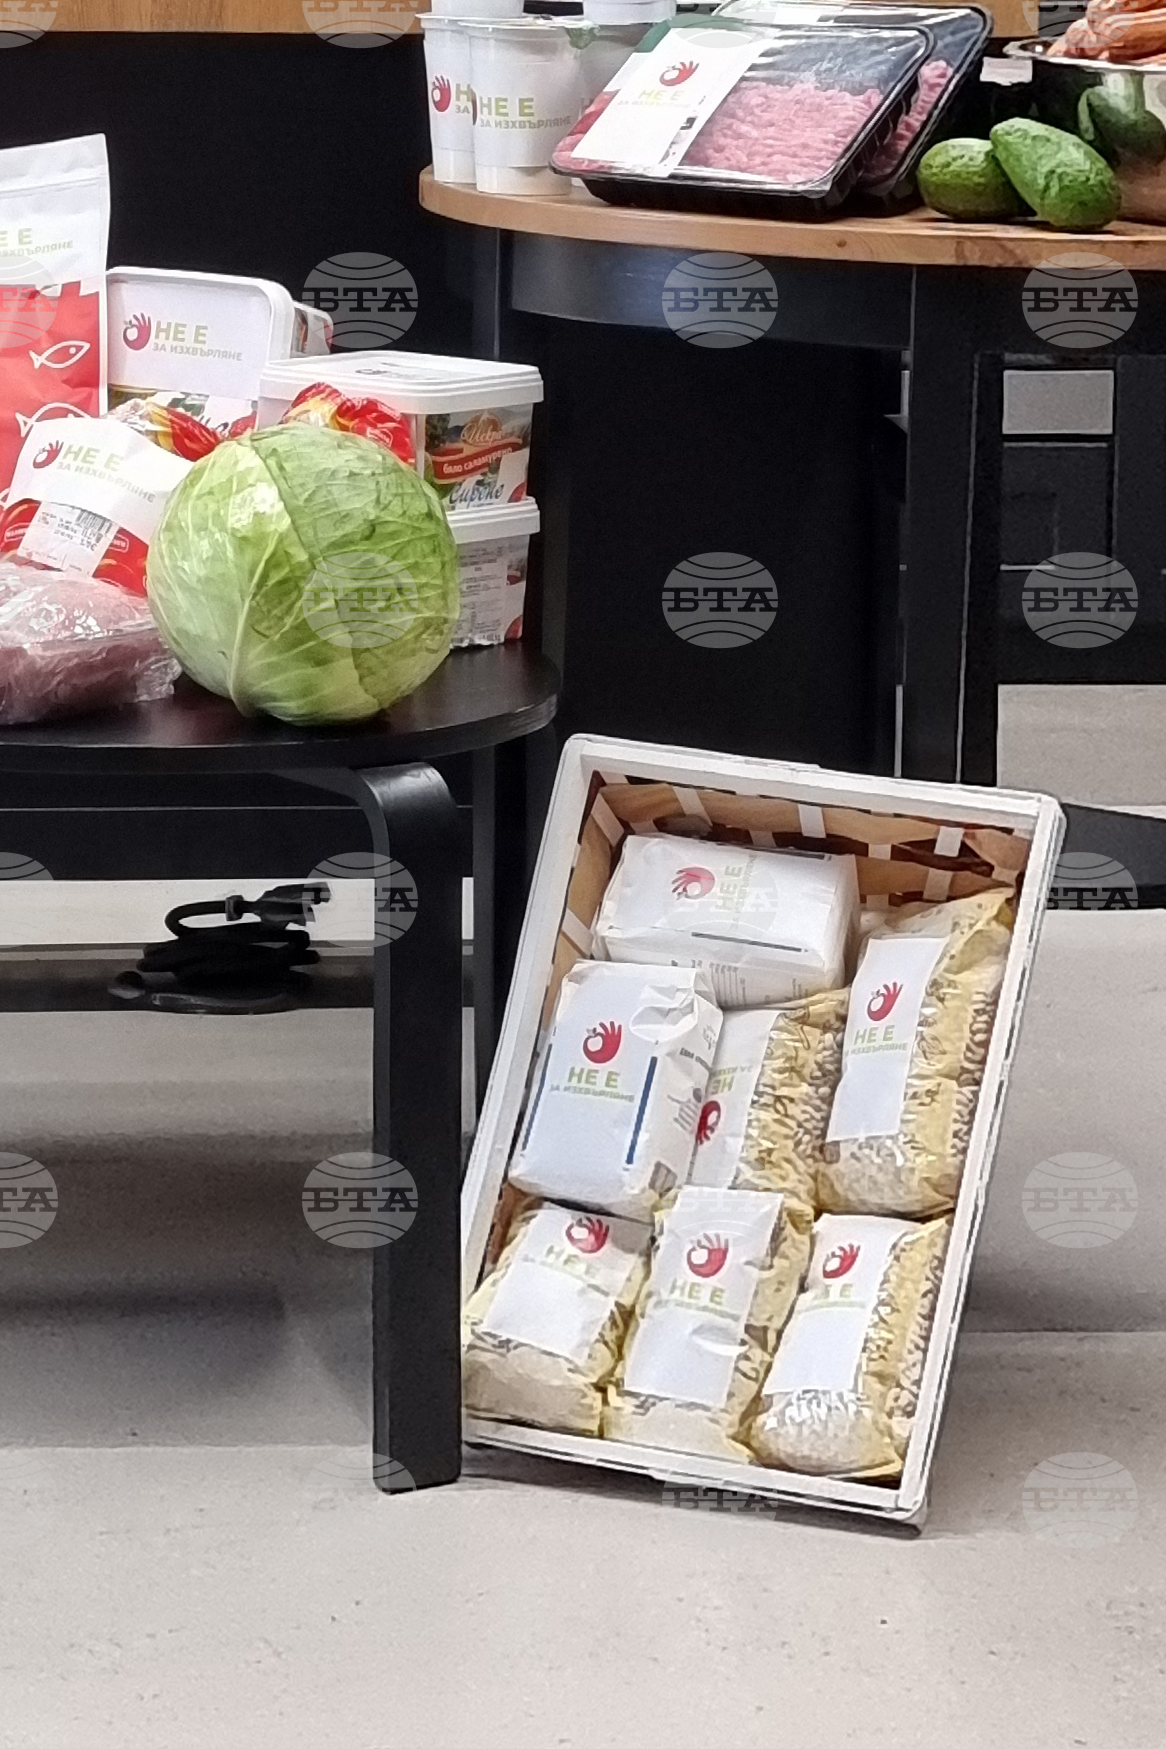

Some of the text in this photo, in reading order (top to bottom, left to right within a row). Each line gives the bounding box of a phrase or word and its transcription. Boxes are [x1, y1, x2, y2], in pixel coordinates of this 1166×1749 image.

[455, 105, 470, 114] ЗА
[479, 96, 535, 117] НЕ Е
[480, 120, 491, 128] ЗА
[18, 227, 33, 246] Е
[154, 320, 209, 345] НЕ Е
[152, 342, 167, 353] ЗА
[56, 461, 71, 472] ЗА
[62, 444, 123, 472] НЕ Е
[442, 447, 513, 476] бяло саламурено
[448, 482, 504, 510] Сирене
[714, 864, 744, 912] НЕ Е
[853, 1024, 896, 1046] НЕ Е
[567, 1066, 621, 1089] НЕ Е
[669, 1278, 726, 1306] НЕ Е
